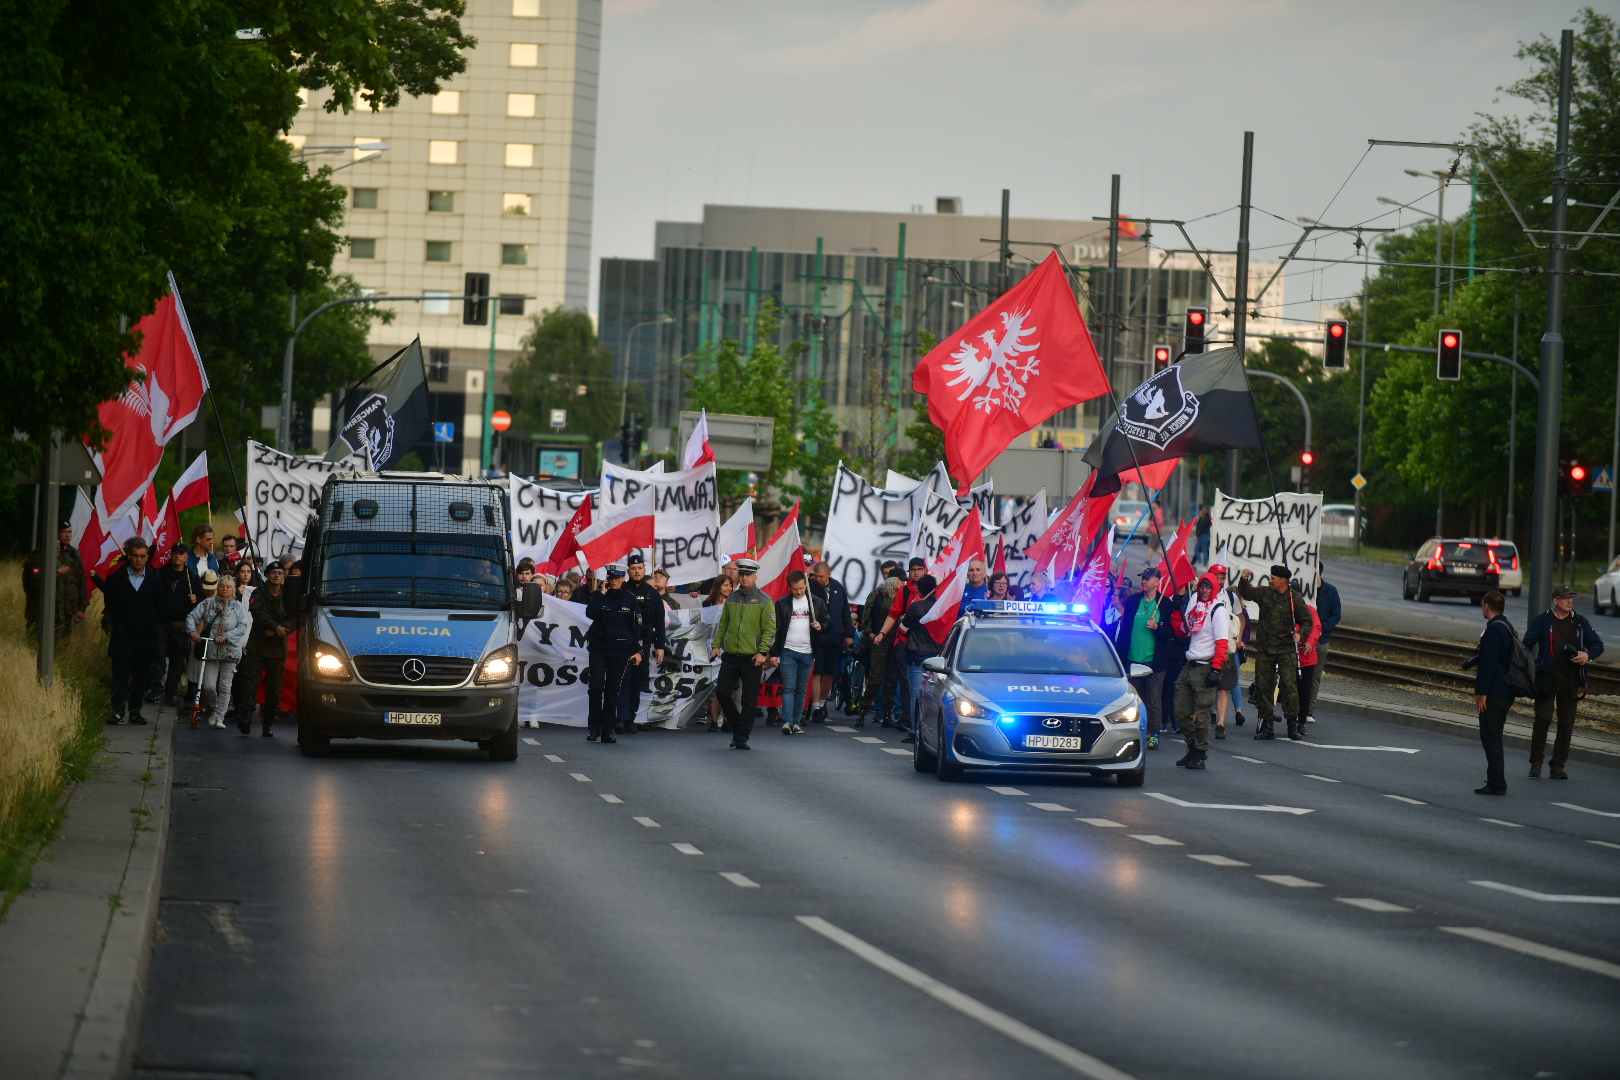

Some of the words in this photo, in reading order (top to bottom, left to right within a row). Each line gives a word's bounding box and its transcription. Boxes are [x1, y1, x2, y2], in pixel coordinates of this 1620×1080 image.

[1006, 602, 1044, 612] POLICJA
[376, 625, 451, 637] POLICJA
[1007, 685, 1090, 695] POLICJA
[390, 713, 412, 724] HPU
[415, 713, 440, 724] C635
[1028, 735, 1049, 746] HPU
[1052, 737, 1079, 748] D283
